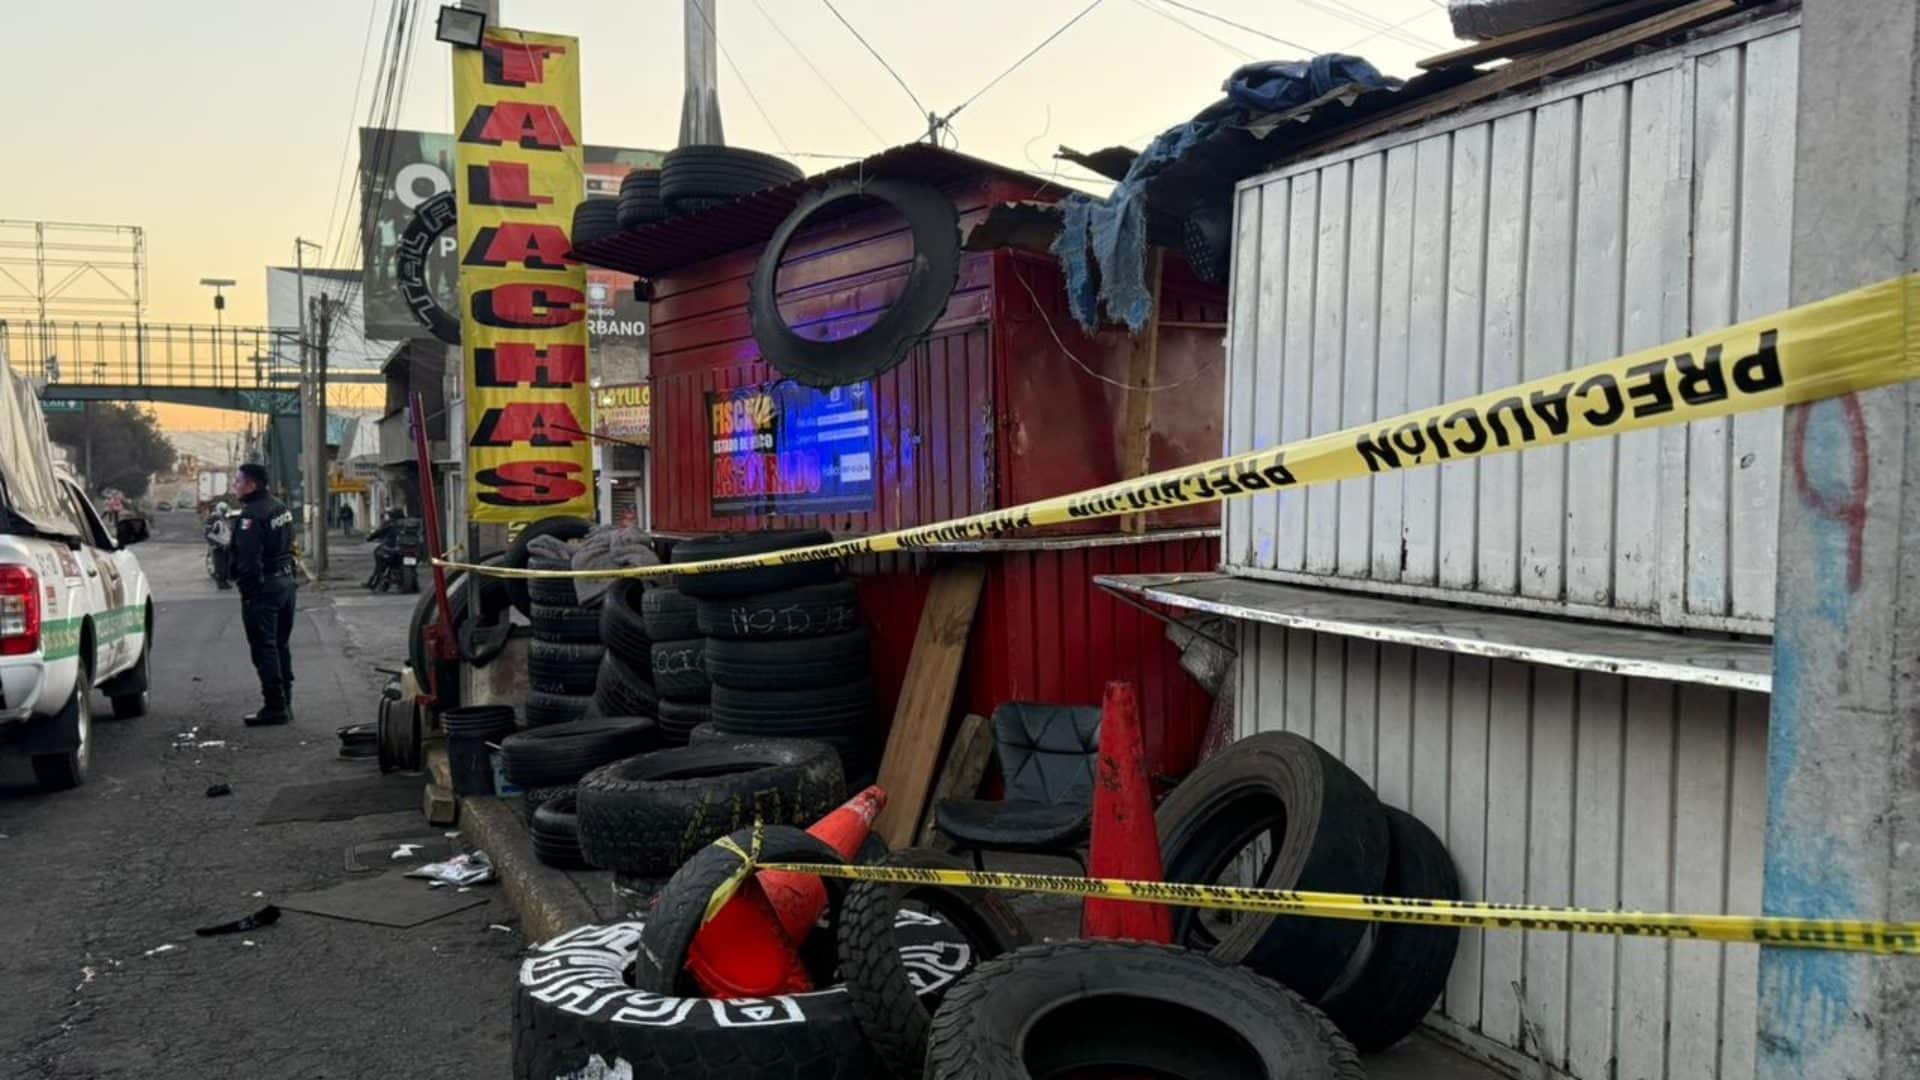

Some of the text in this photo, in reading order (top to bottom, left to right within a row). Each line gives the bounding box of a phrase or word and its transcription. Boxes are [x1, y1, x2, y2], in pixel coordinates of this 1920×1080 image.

[457, 41, 588, 507] TALACHAS
[587, 319, 646, 337] RBANO
[1356, 328, 1784, 473] PRECAUCIÓN
